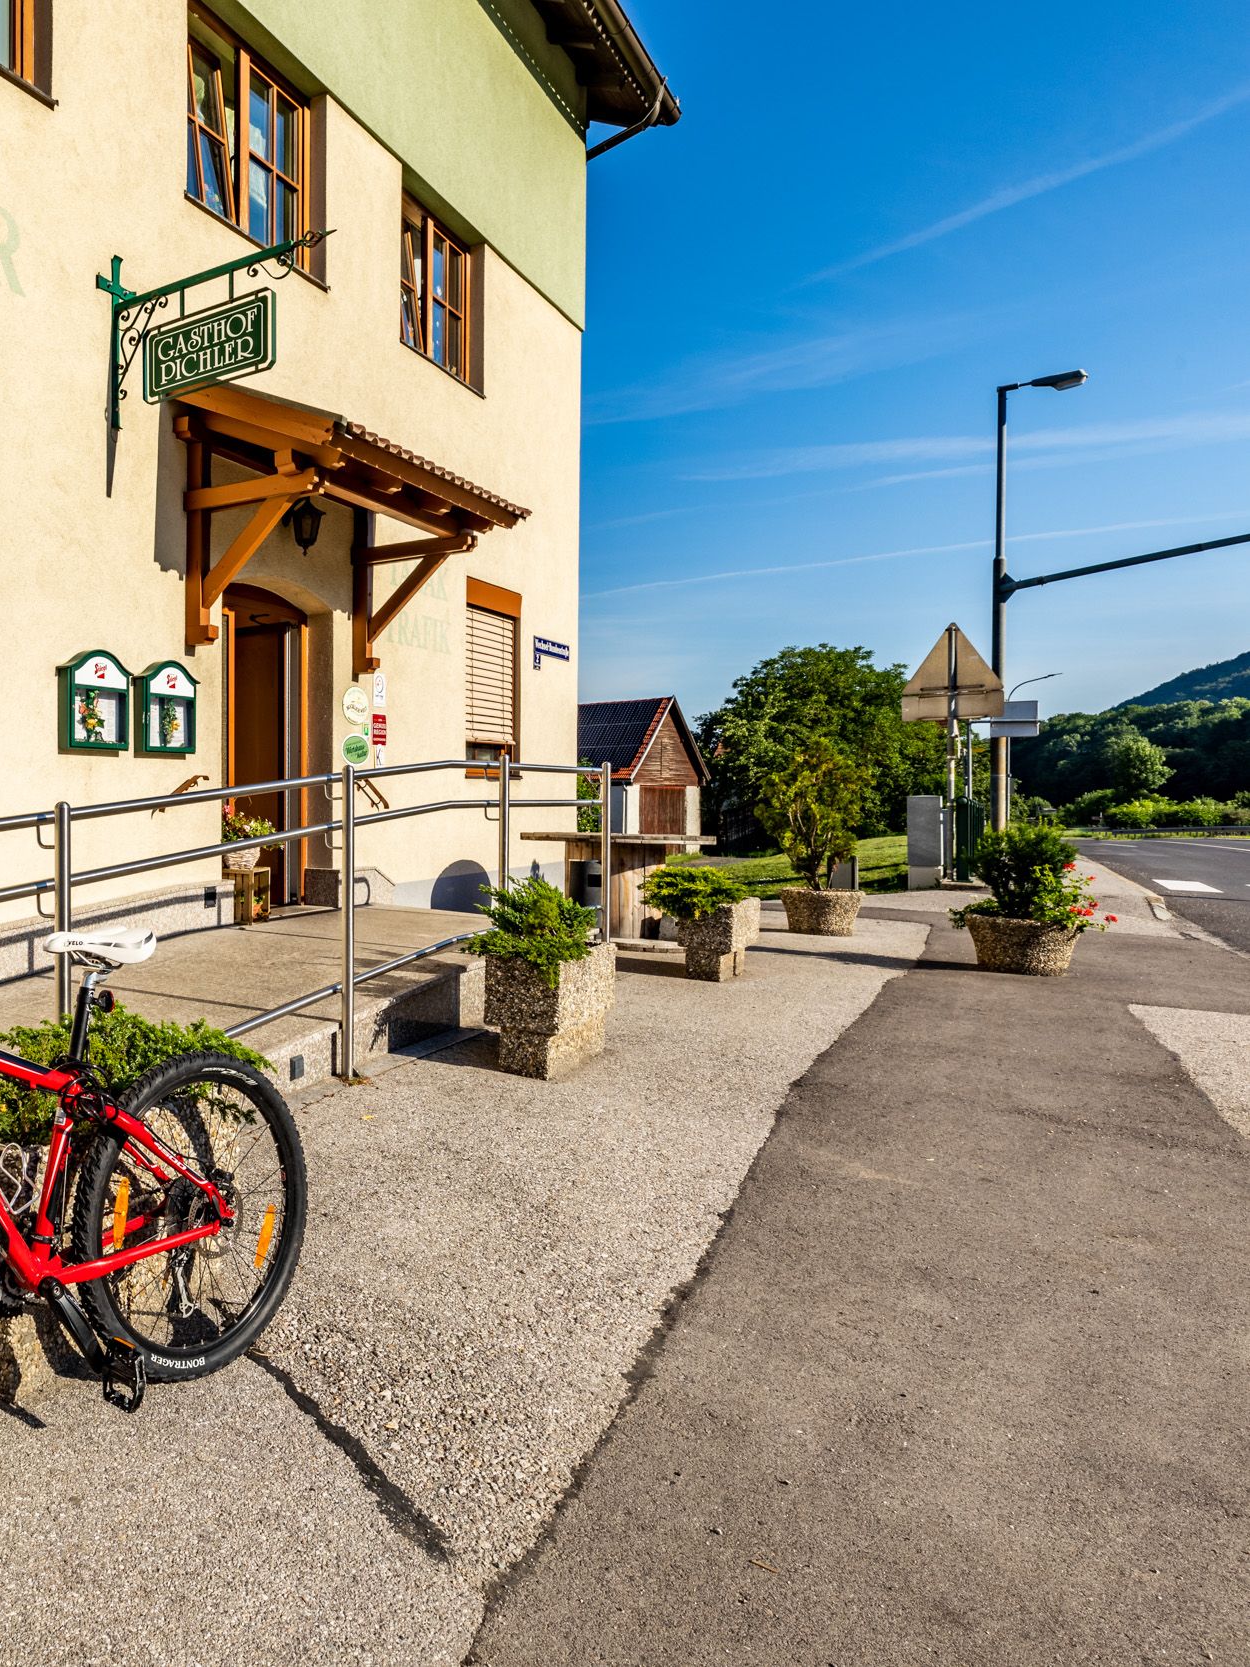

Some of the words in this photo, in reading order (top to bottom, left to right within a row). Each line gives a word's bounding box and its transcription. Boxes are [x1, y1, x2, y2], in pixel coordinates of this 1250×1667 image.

[157, 307, 258, 361] GASTHOF
[160, 336, 255, 385] PICHLER
[150, 1353, 206, 1369] BONTRAGER
